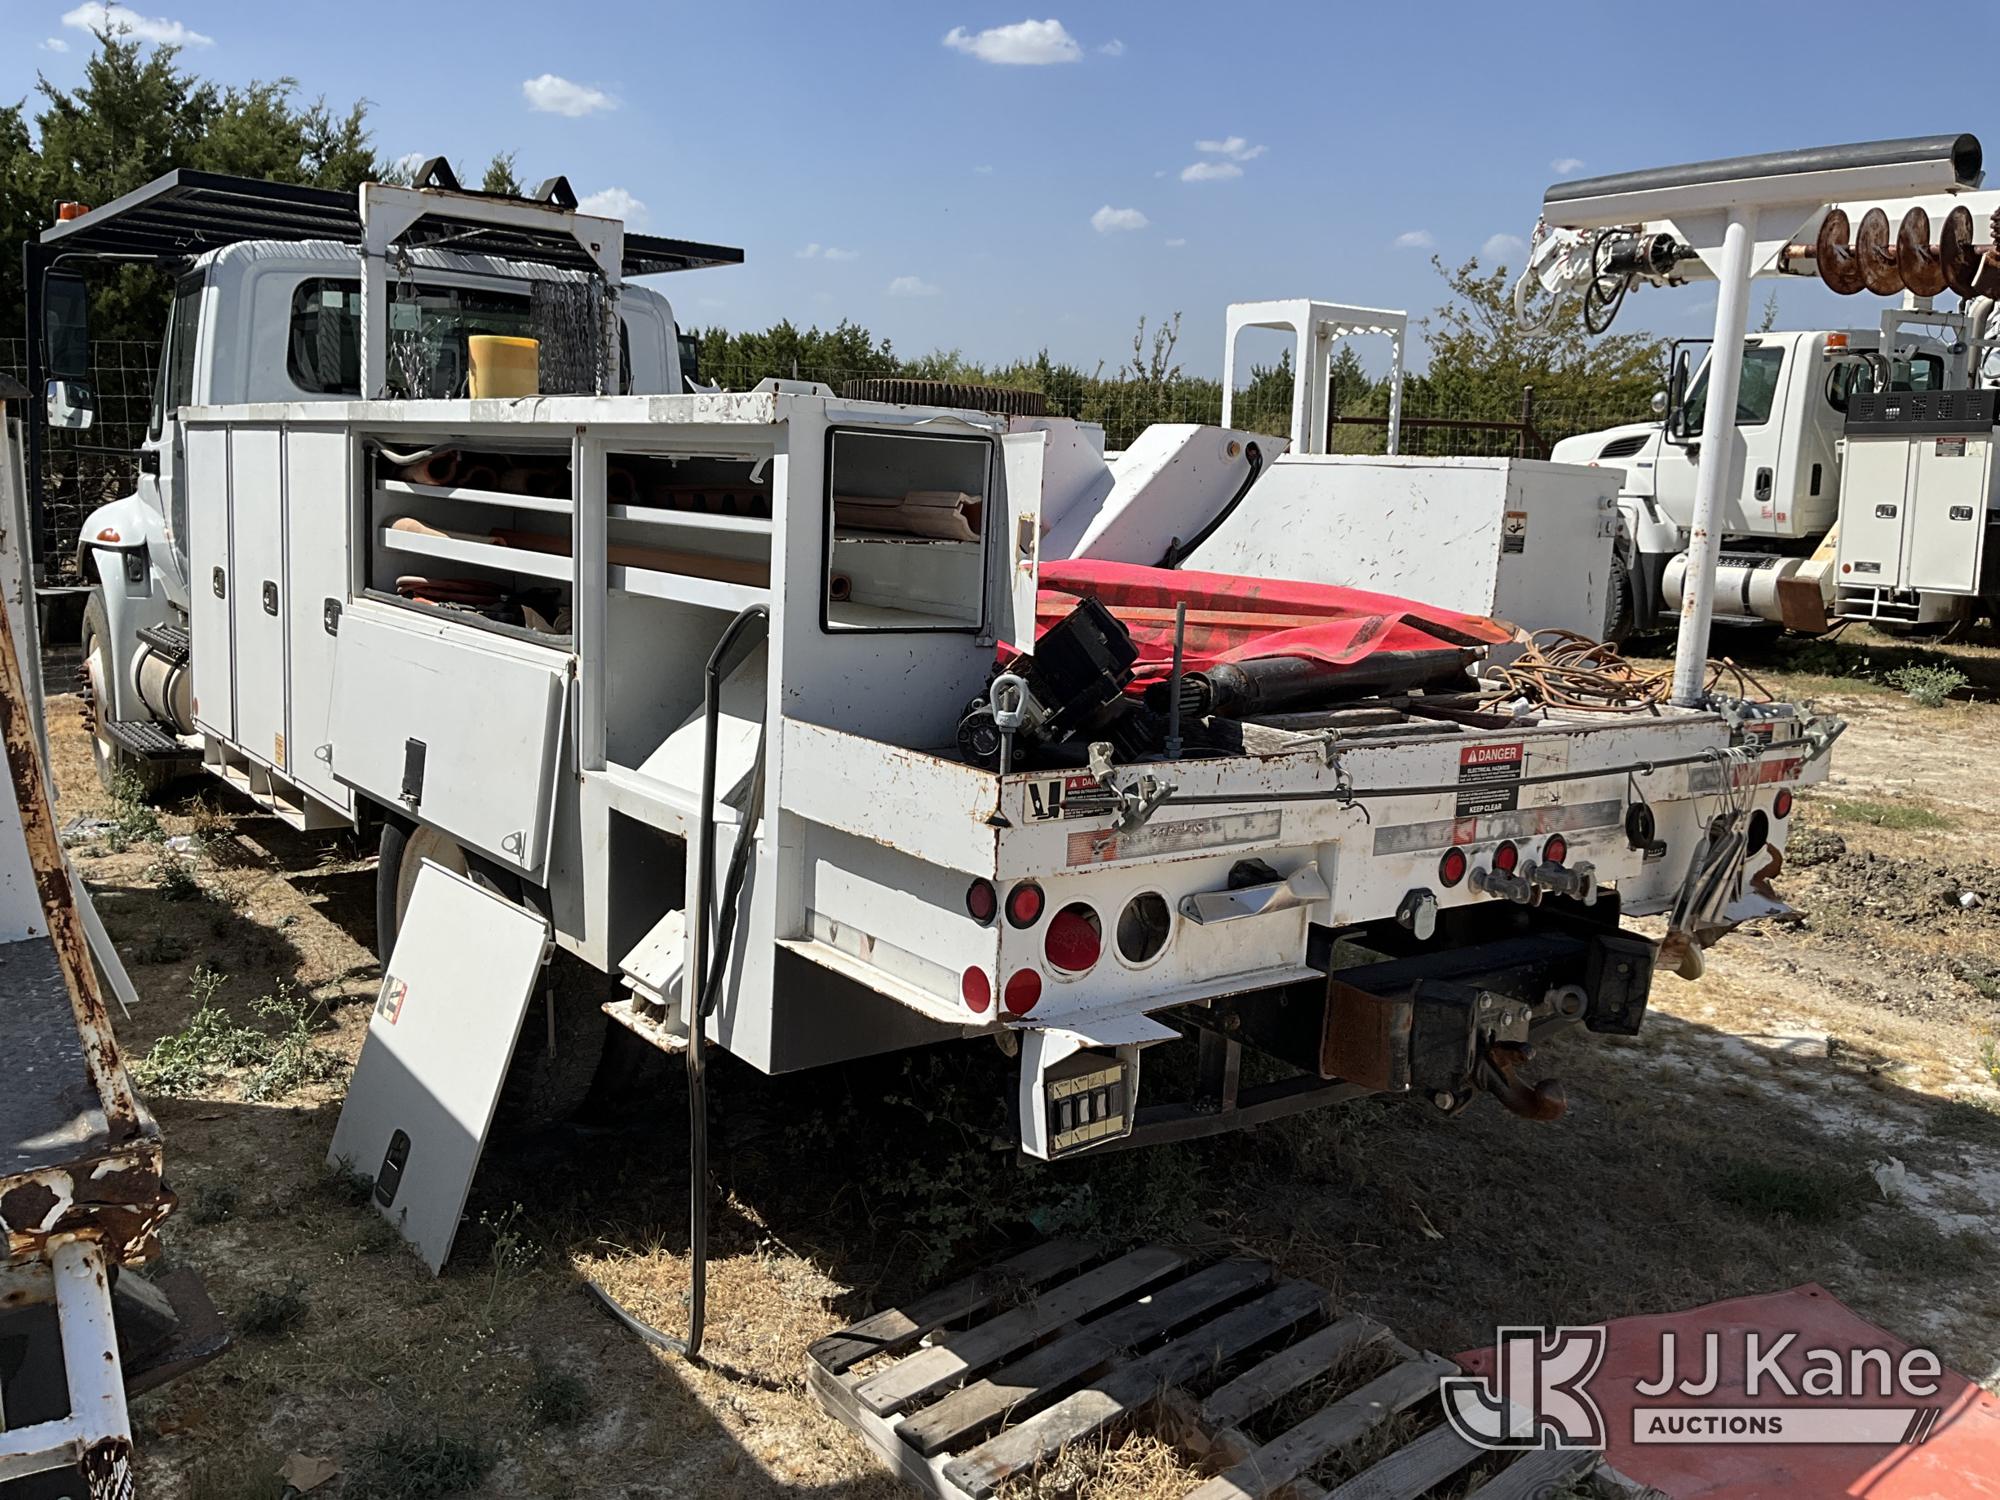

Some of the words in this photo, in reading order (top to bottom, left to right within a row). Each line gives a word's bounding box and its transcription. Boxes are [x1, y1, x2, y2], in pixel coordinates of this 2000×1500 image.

[1478, 747, 1517, 762] DANGER
[1469, 805, 1484, 814] KEEP
[1484, 803, 1502, 812] CLEAR
